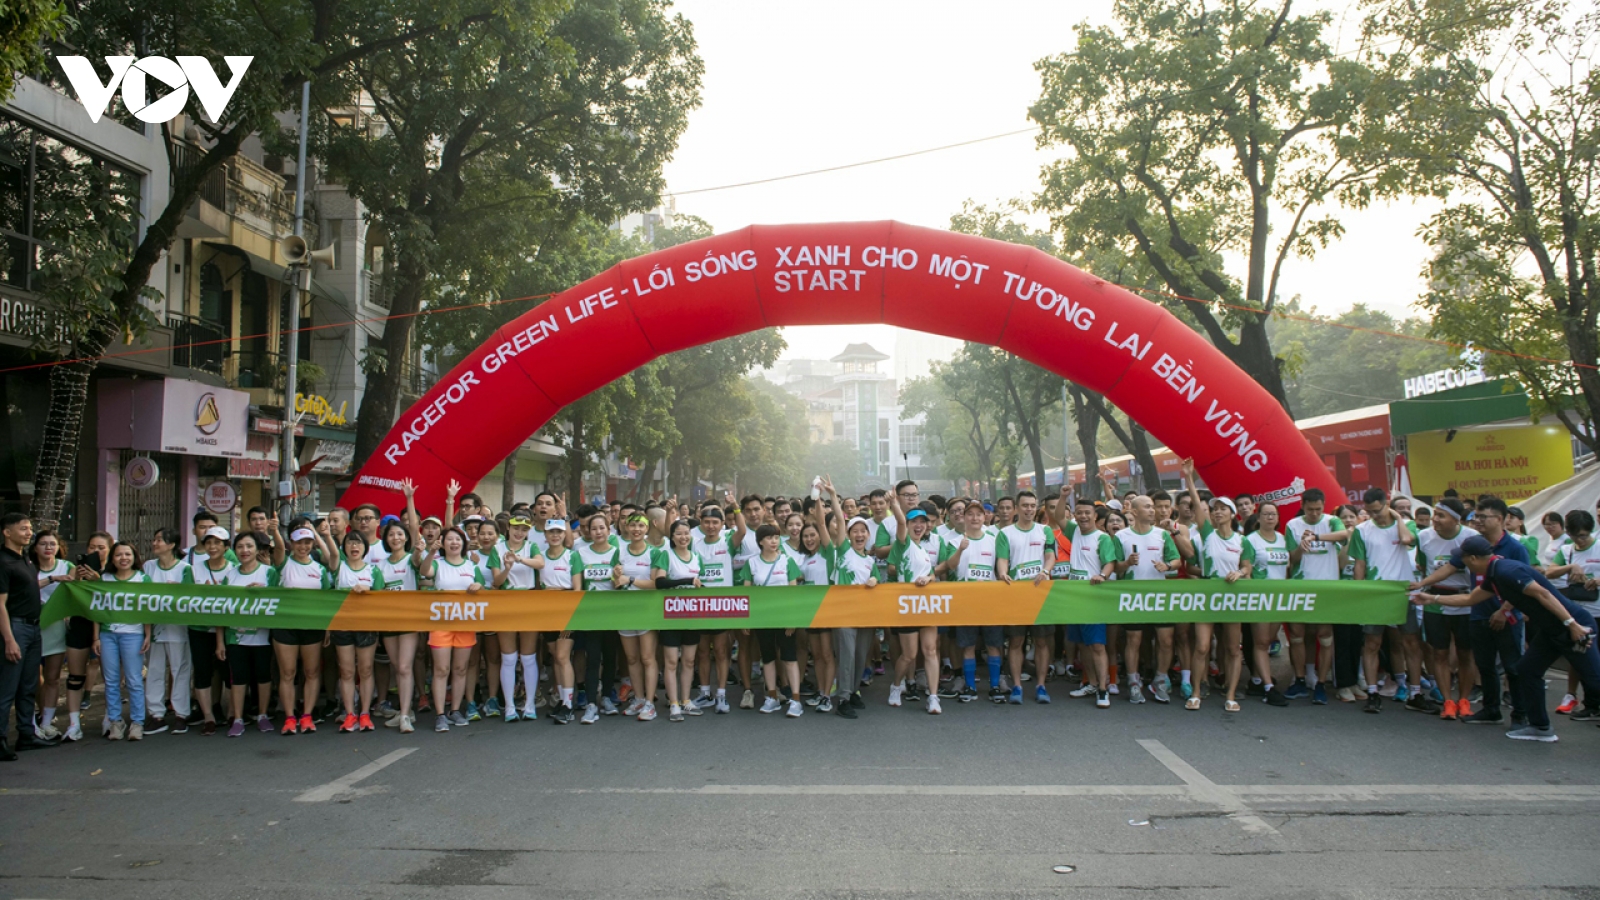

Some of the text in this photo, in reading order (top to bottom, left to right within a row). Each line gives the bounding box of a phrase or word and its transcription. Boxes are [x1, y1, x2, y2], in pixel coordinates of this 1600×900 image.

[773, 269, 866, 293] START
[481, 314, 560, 374] GREEN
[564, 286, 619, 324] LIFE
[632, 263, 675, 297] LỐI
[684, 249, 758, 283] SỐNG
[775, 245, 851, 268] XANH
[861, 245, 918, 270] CHO
[928, 253, 990, 290] MỘT
[1003, 270, 1096, 331] TƯƠNG
[1103, 321, 1154, 361] LAI
[1151, 352, 1206, 404] BỀN
[1203, 398, 1268, 472] VỮNG
[1404, 367, 1467, 400] HABECO
[1454, 461, 1471, 471] BIA
[1494, 457, 1508, 468] HÀ
[1510, 456, 1529, 469] NỘI
[1492, 478, 1510, 487] DUY
[587, 569, 609, 577] 5537
[970, 569, 991, 578] 5012
[1020, 566, 1041, 576] 5079
[90, 591, 280, 616] RACE FOR GREEN LIFE
[429, 601, 489, 621] START
[898, 594, 953, 615] START
[1118, 593, 1317, 612] RACE FOR GREEN LIFE
